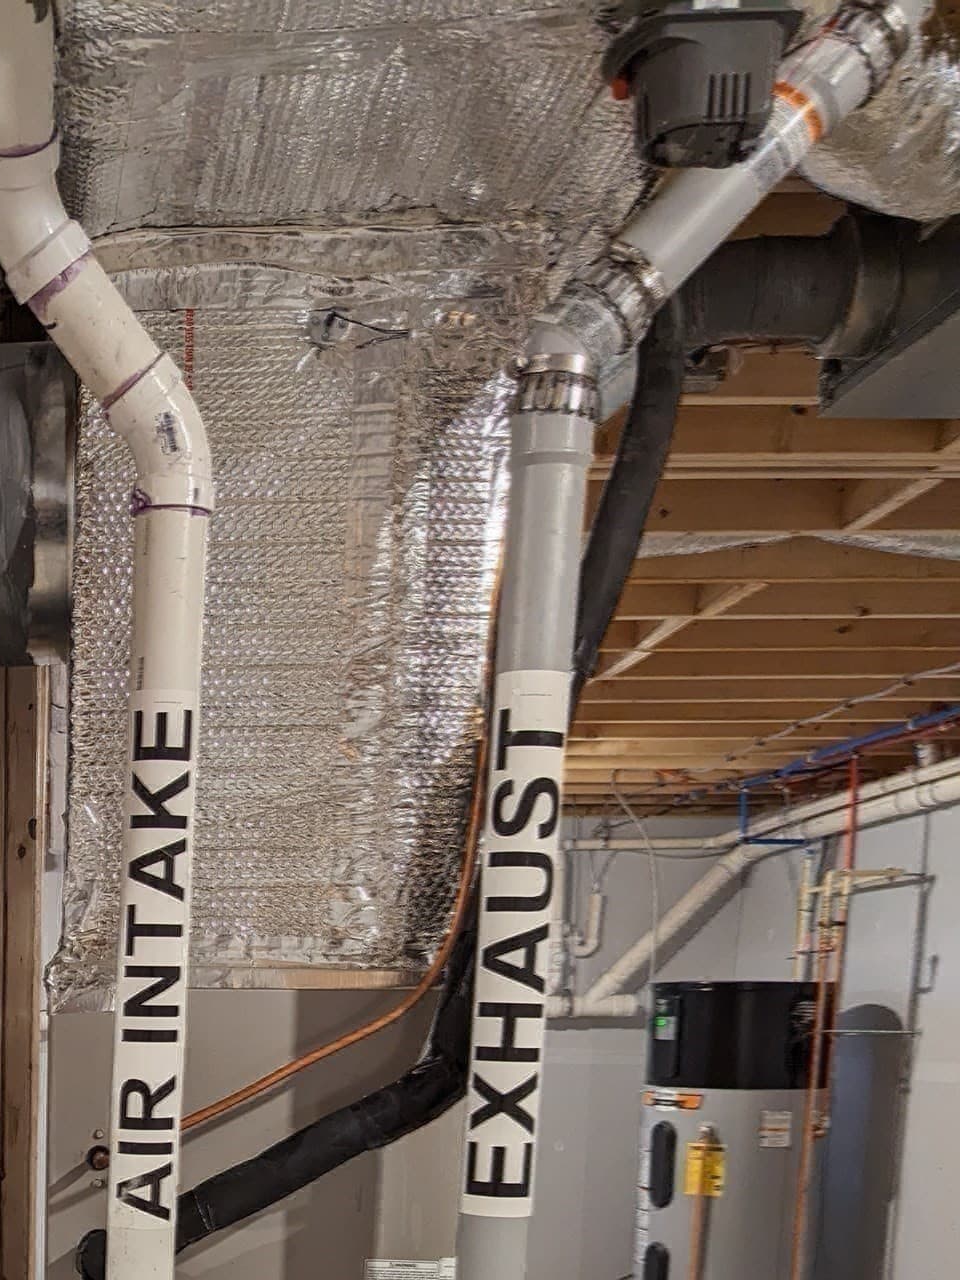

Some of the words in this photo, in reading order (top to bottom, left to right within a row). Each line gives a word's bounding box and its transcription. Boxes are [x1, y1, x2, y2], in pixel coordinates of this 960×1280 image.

[122, 709, 193, 1044] INTAKE
[466, 708, 565, 1198] EXHAUST
[117, 1077, 177, 1222] AIR
